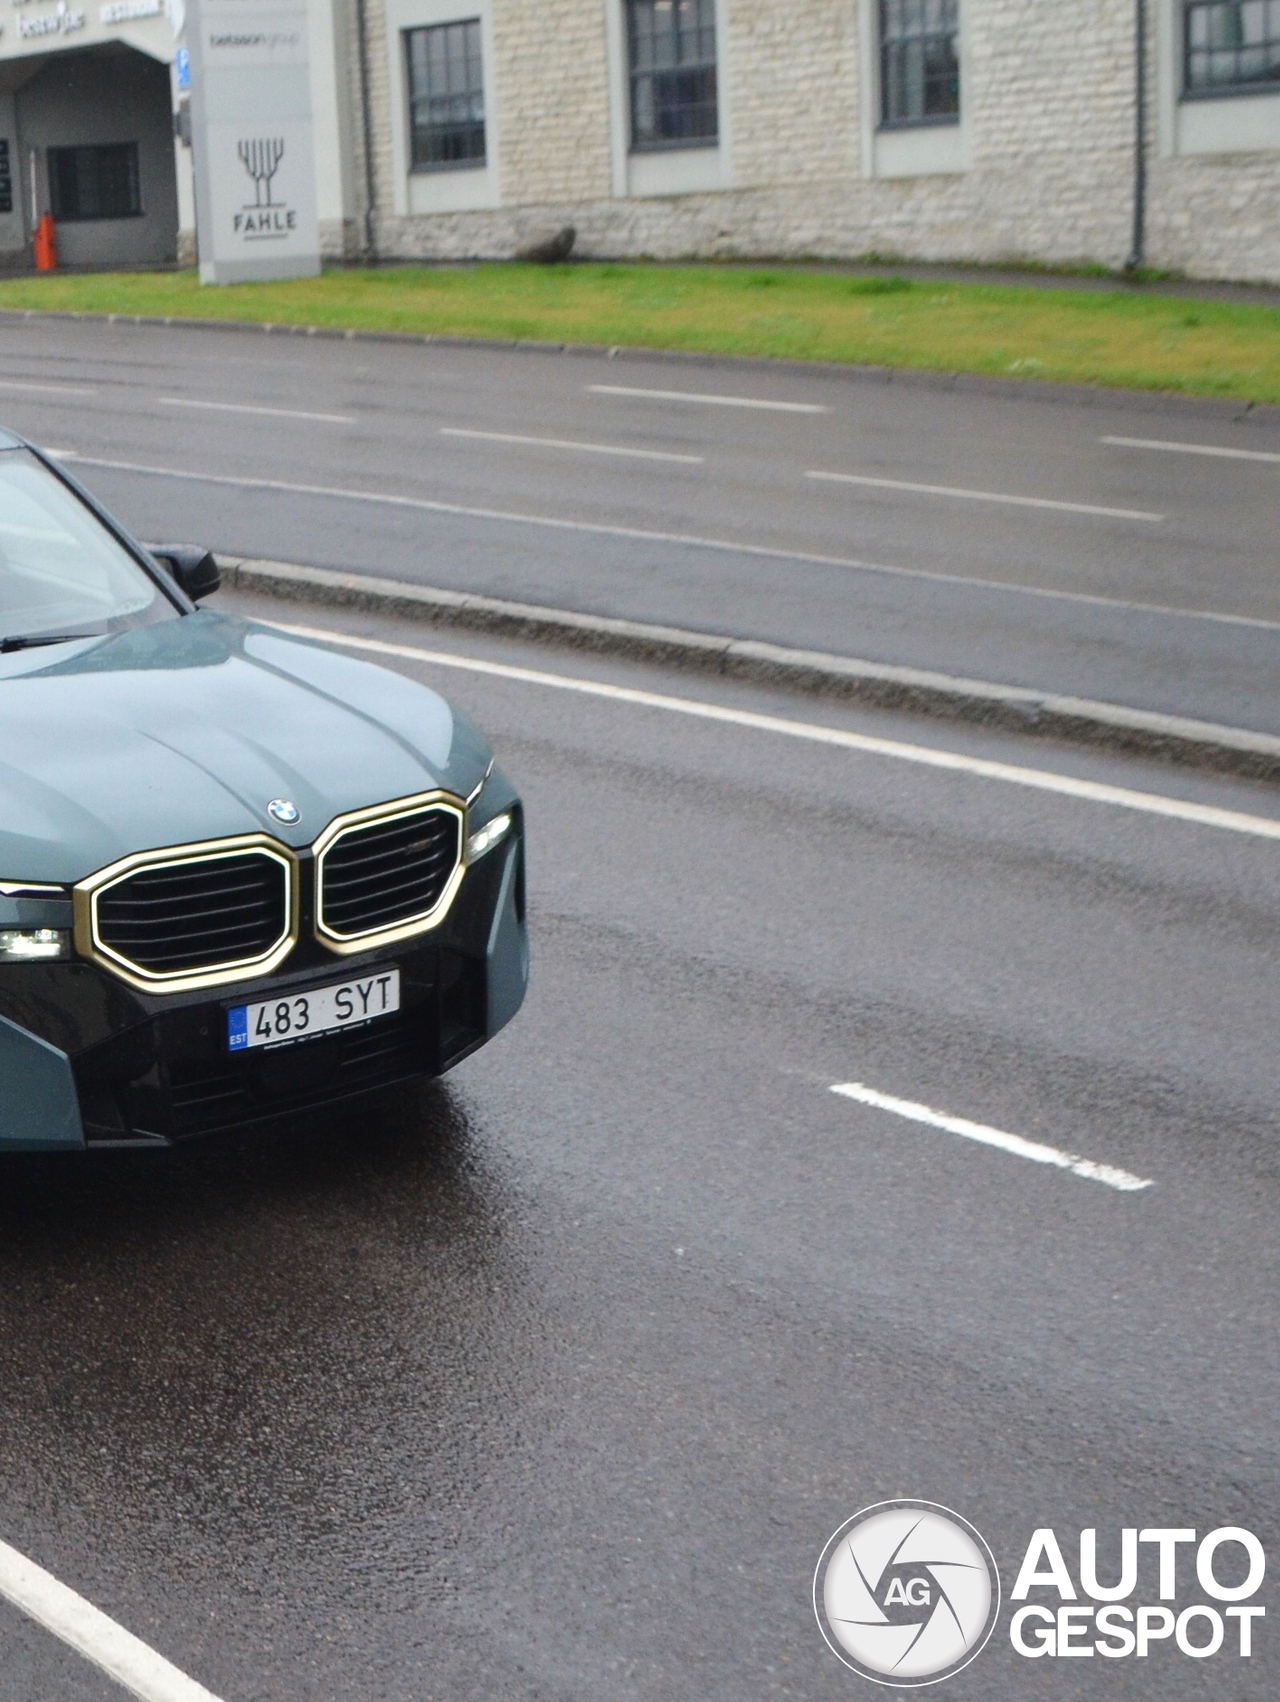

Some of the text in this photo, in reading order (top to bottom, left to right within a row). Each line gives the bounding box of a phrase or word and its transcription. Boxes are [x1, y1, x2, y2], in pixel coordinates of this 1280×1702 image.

[233, 210, 297, 232] FAHLE
[229, 1034, 247, 1045] EST
[255, 998, 310, 1038] 483
[335, 976, 391, 1020] SYT
